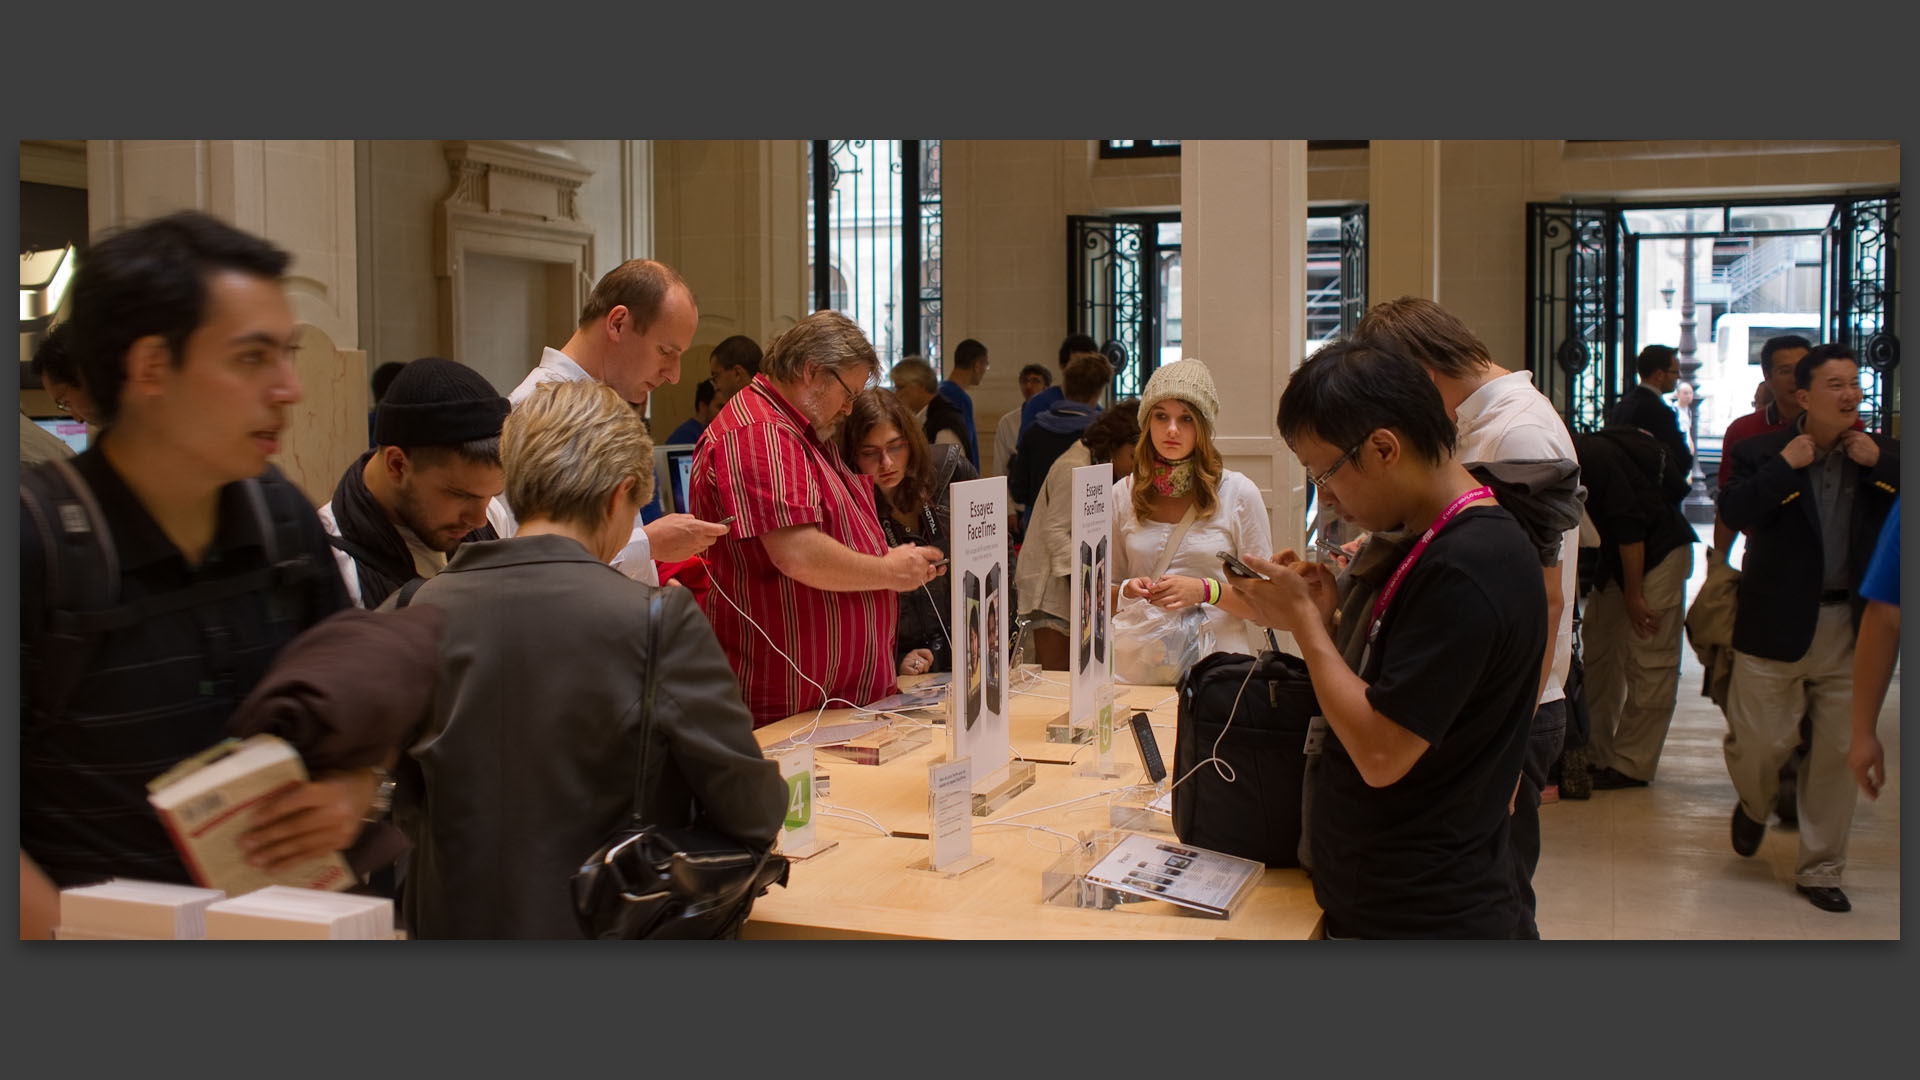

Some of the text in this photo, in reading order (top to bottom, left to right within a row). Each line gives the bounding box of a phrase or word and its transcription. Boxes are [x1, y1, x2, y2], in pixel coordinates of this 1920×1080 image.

[1086, 483, 1103, 499] Essayez
[970, 501, 994, 519] Essayez
[1083, 500, 1105, 517] FaceTime
[967, 521, 996, 541] FaceTime
[1102, 711, 1110, 746] 6
[790, 780, 804, 819] 4
